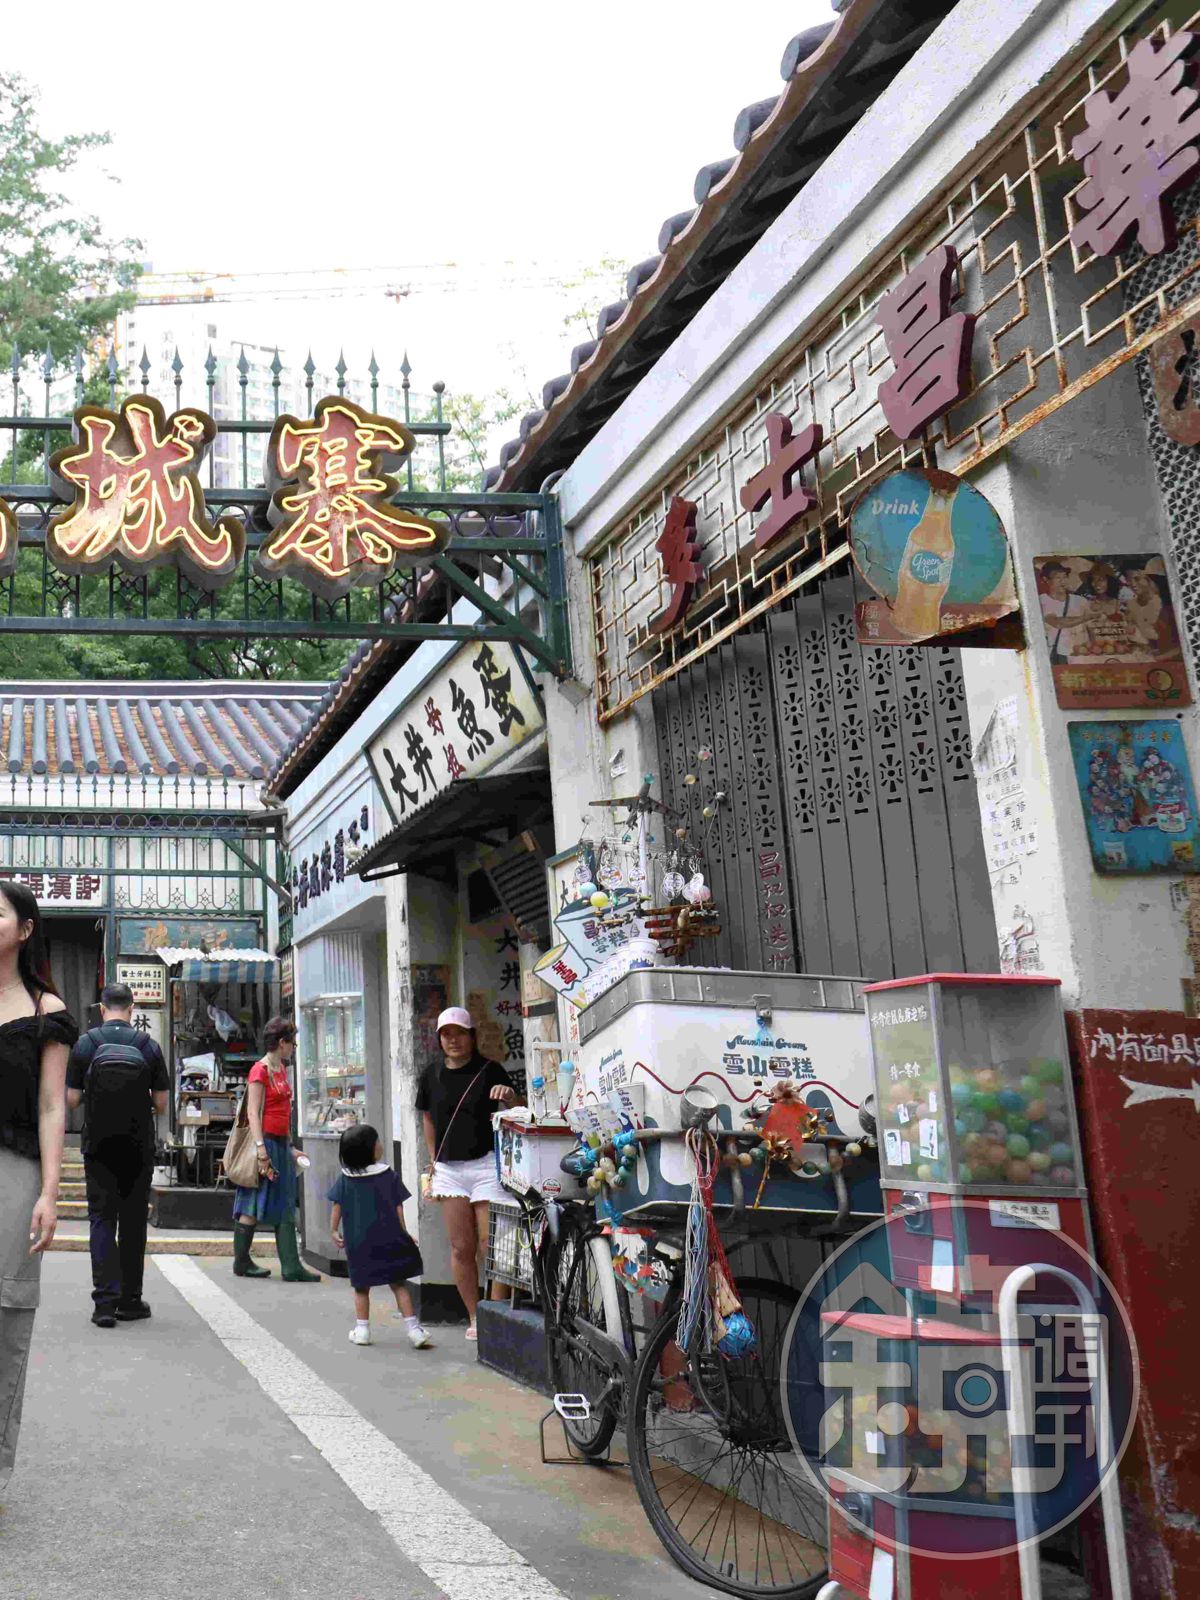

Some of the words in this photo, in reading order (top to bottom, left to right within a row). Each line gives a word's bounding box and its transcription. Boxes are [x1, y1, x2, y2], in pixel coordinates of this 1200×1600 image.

[872, 499, 920, 515] Drink
[912, 553, 940, 571] Green
[722, 1053, 817, 1080] 雪山雪糕
